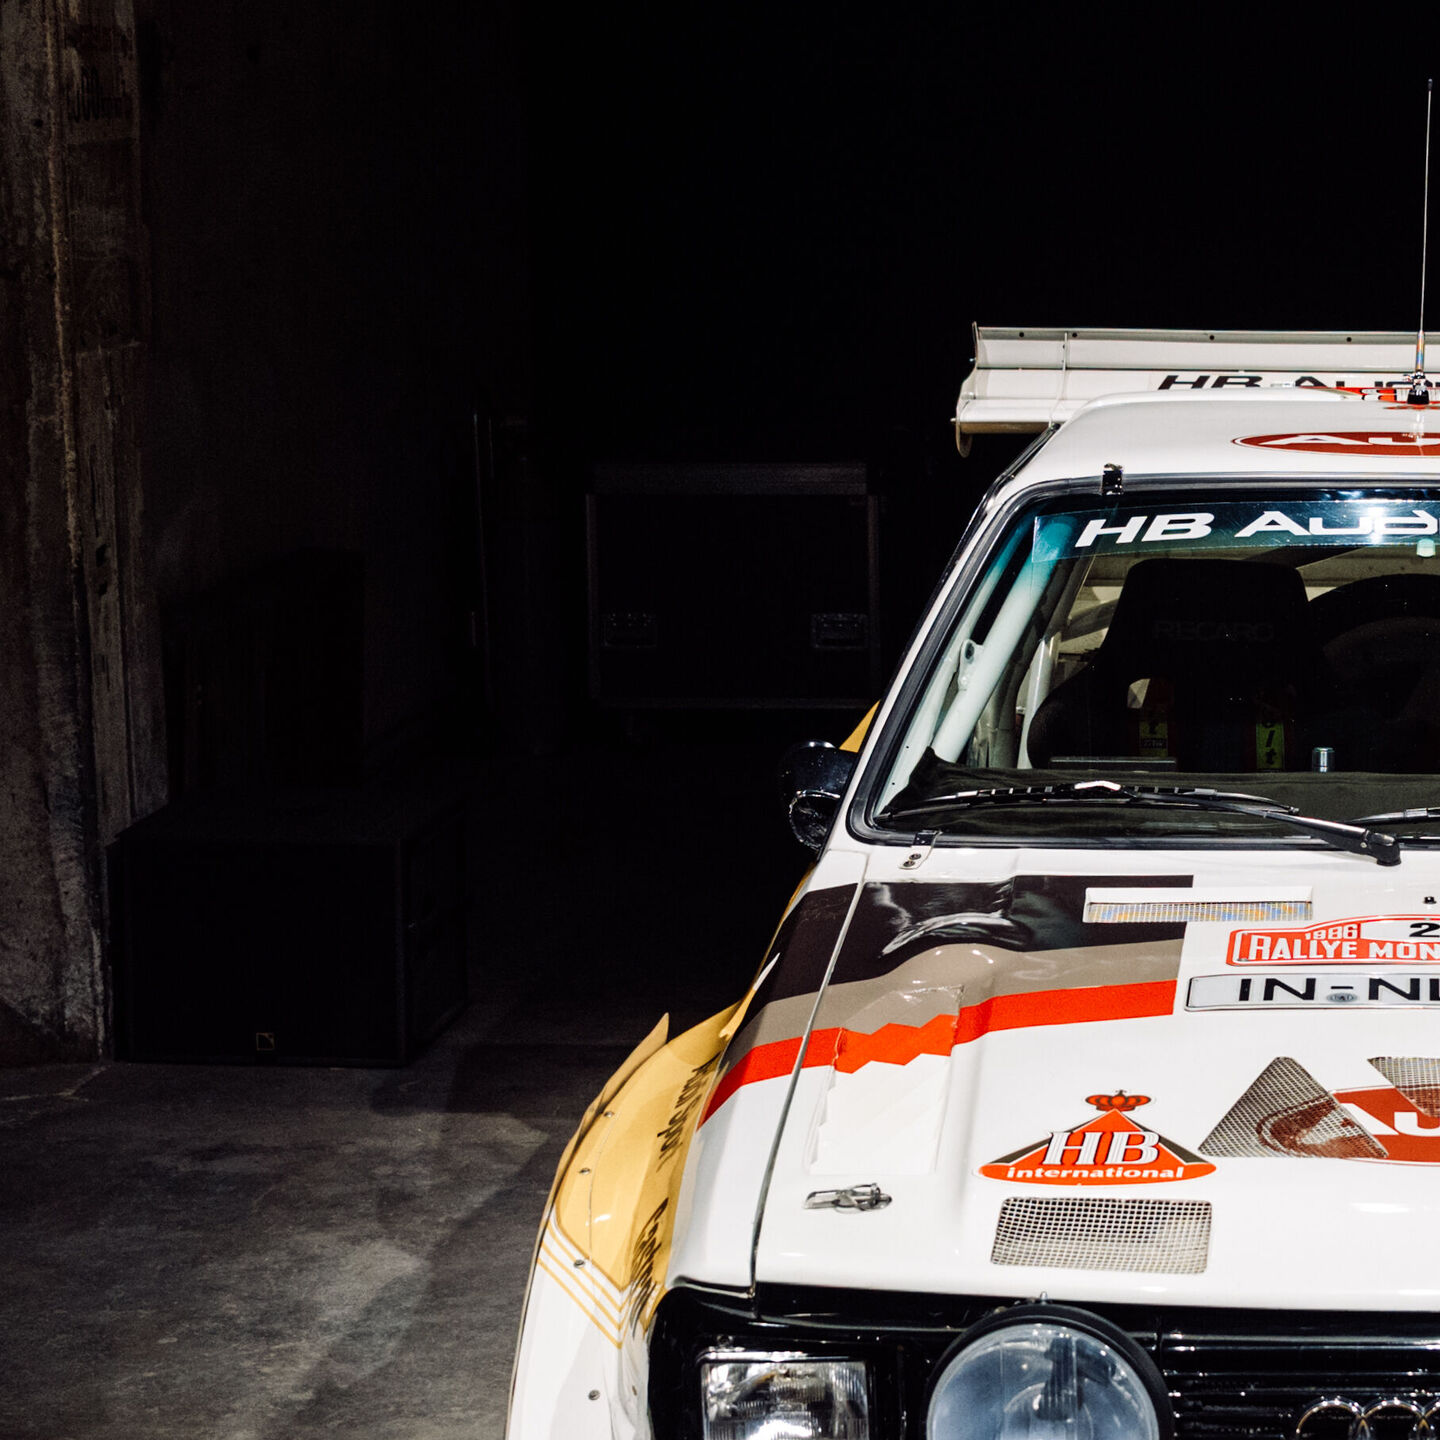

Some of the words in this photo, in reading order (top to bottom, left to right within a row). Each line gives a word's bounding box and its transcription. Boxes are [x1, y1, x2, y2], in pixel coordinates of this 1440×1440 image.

[1075, 512, 1215, 548] HB
[1304, 923, 1358, 941] 1986
[1409, 922, 1440, 938] 2
[1247, 934, 1358, 960] RALLYE
[1040, 1130, 1161, 1166] HB
[1006, 1165, 1185, 1180] international
